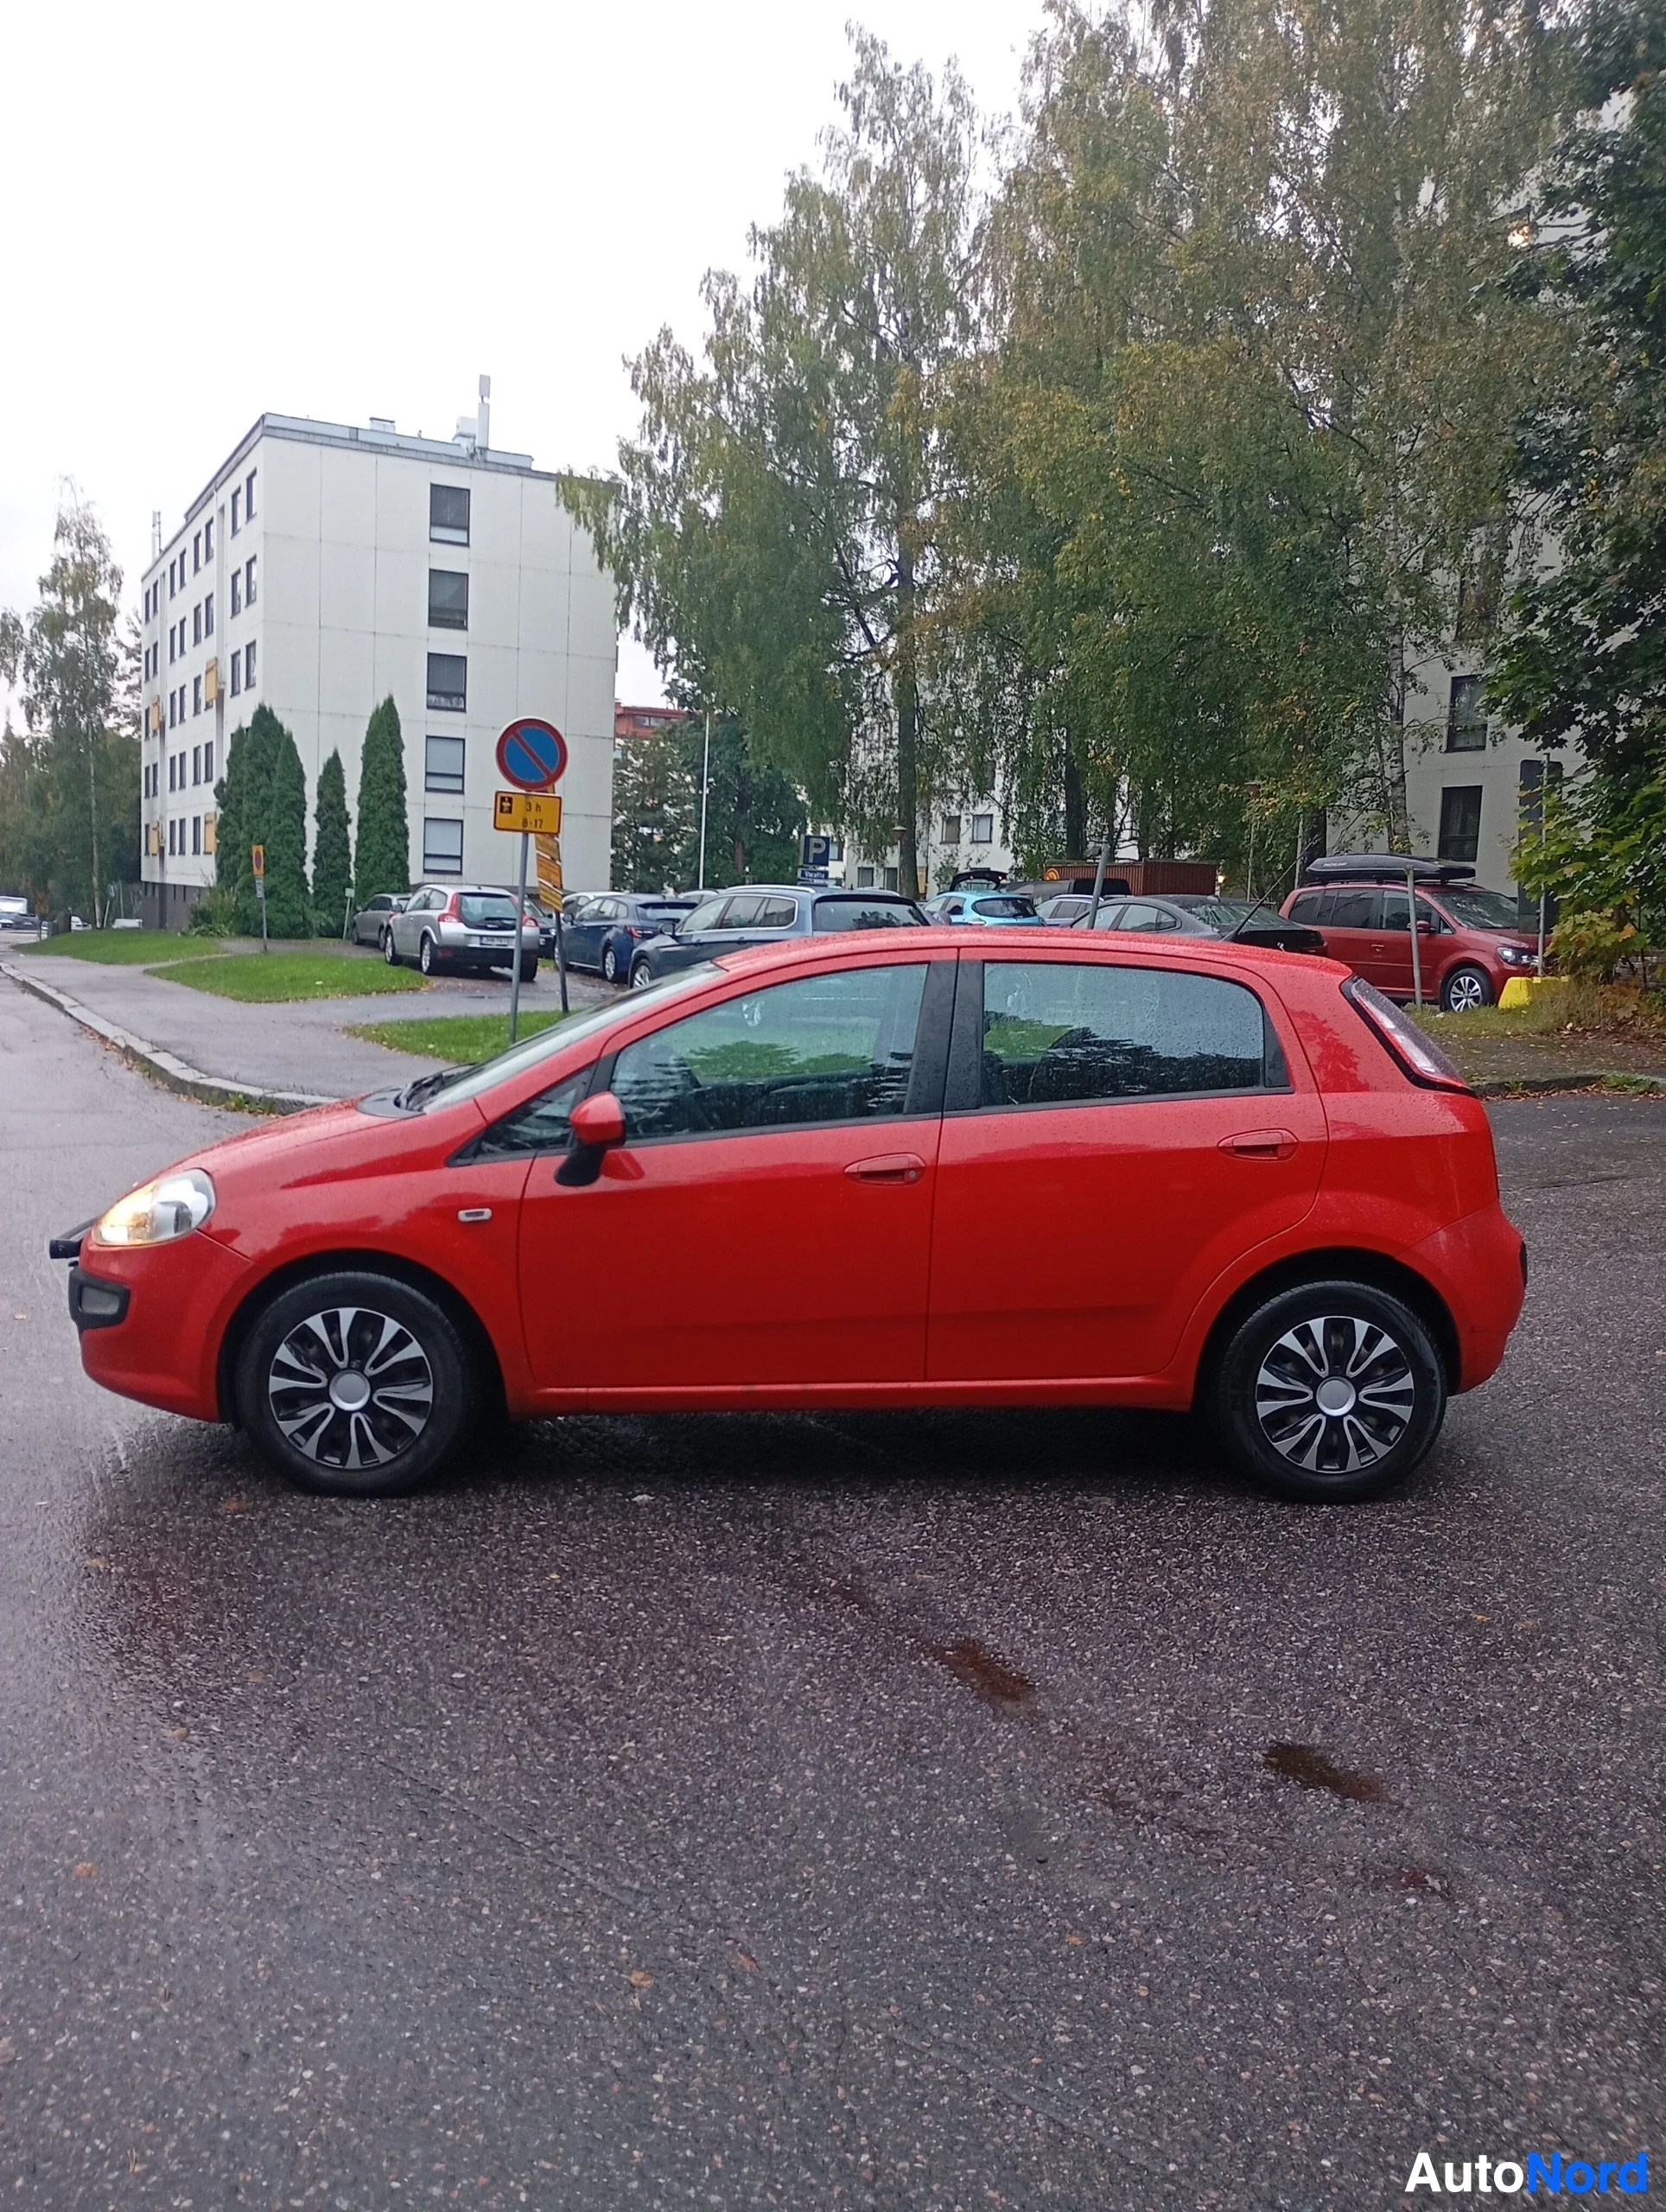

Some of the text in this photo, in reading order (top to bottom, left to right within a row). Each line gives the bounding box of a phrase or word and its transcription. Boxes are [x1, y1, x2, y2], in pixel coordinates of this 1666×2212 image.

[525, 801, 542, 813] 3 h
[808, 837, 826, 863] P
